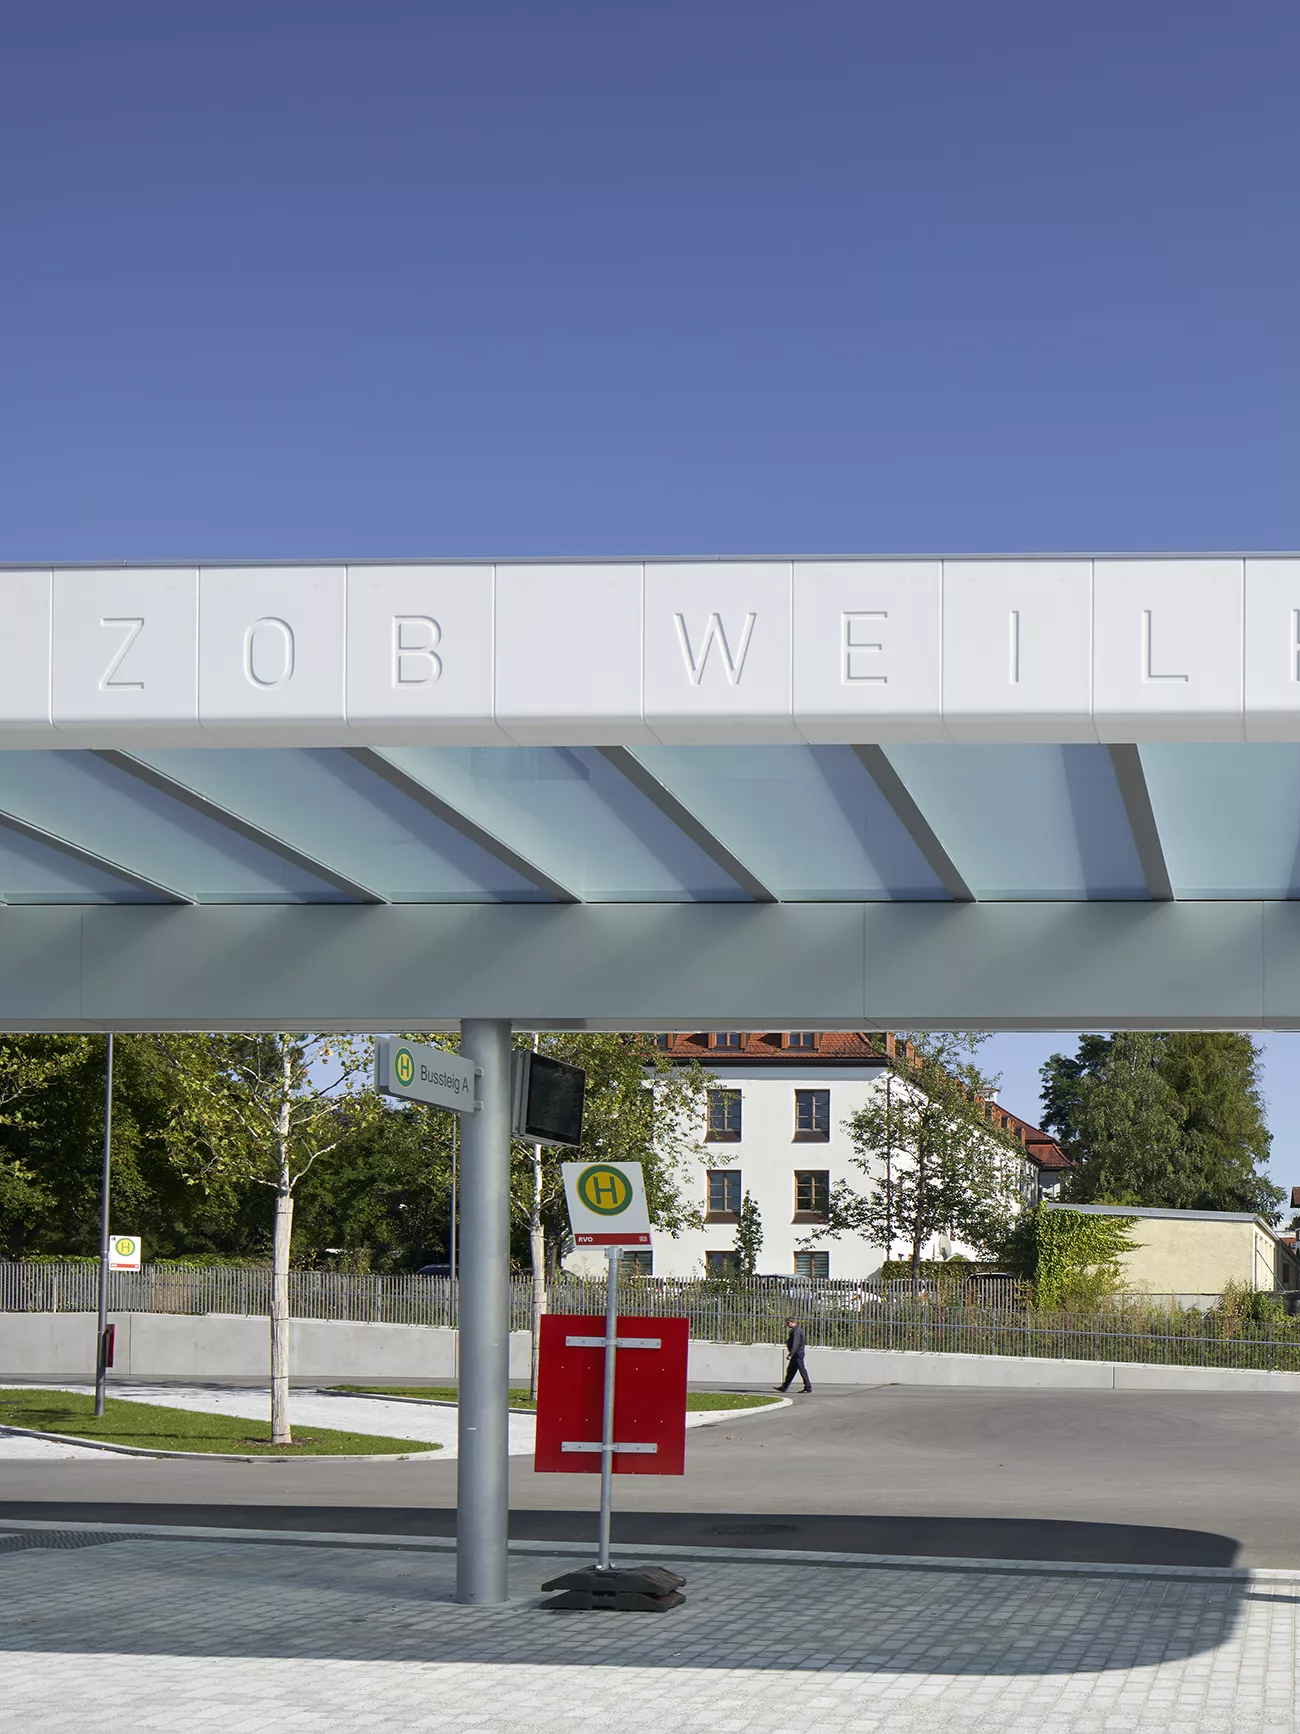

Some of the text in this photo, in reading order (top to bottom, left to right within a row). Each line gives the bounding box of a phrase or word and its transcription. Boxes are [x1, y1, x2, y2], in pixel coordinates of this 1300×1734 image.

[98, 614, 443, 690] ZOB
[400, 1056, 410, 1078] H
[420, 1064, 470, 1094] Bussteig A
[593, 1176, 618, 1204] H
